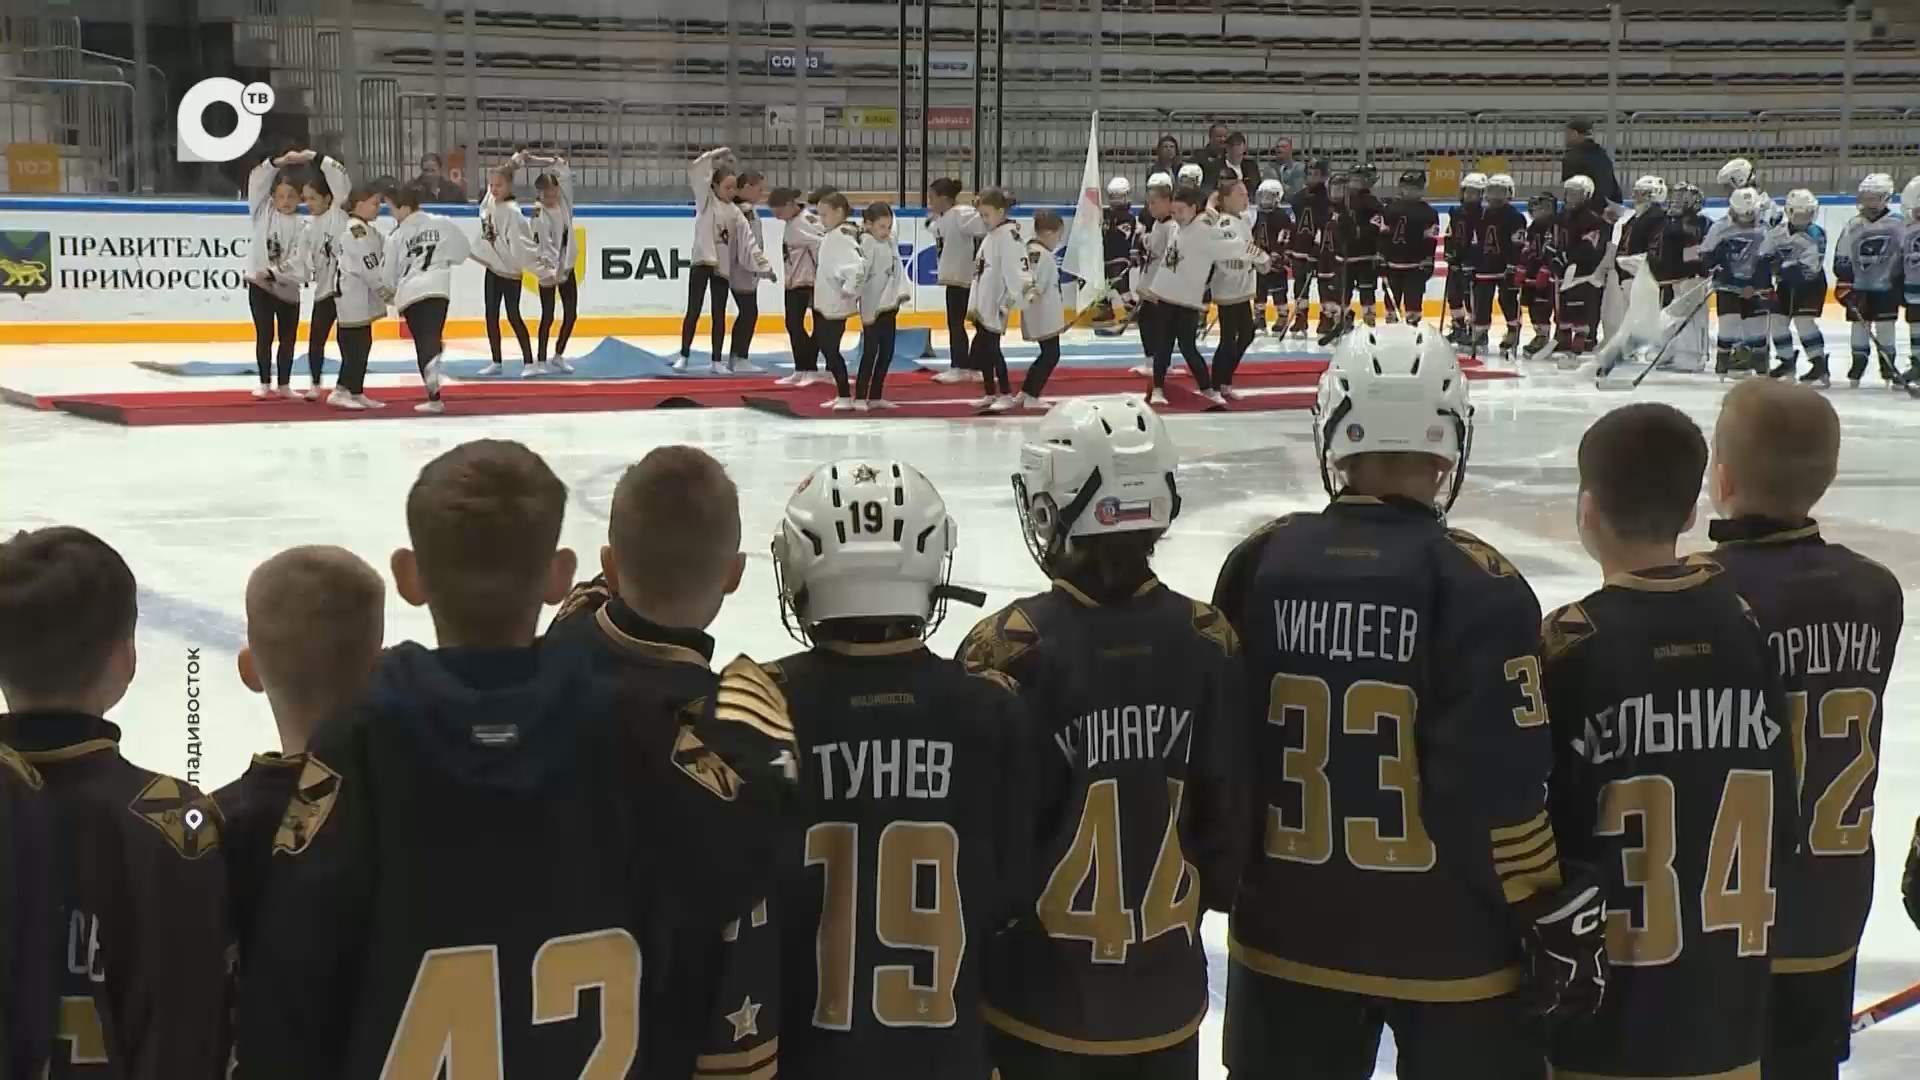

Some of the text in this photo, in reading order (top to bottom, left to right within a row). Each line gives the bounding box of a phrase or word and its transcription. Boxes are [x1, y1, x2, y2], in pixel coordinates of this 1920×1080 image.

[58, 235, 253, 259] ПРАВИТЕЛЬС
[848, 500, 884, 534] 19
[1273, 599, 1418, 662] КИНДЕЕВ
[1053, 704, 1194, 768] КУШНАРУ
[811, 738, 954, 801] ТУНЕВ
[1265, 672, 1437, 873] 33
[1593, 768, 1777, 967] 34
[804, 820, 967, 1032] 19
[379, 927, 643, 1080] 42
